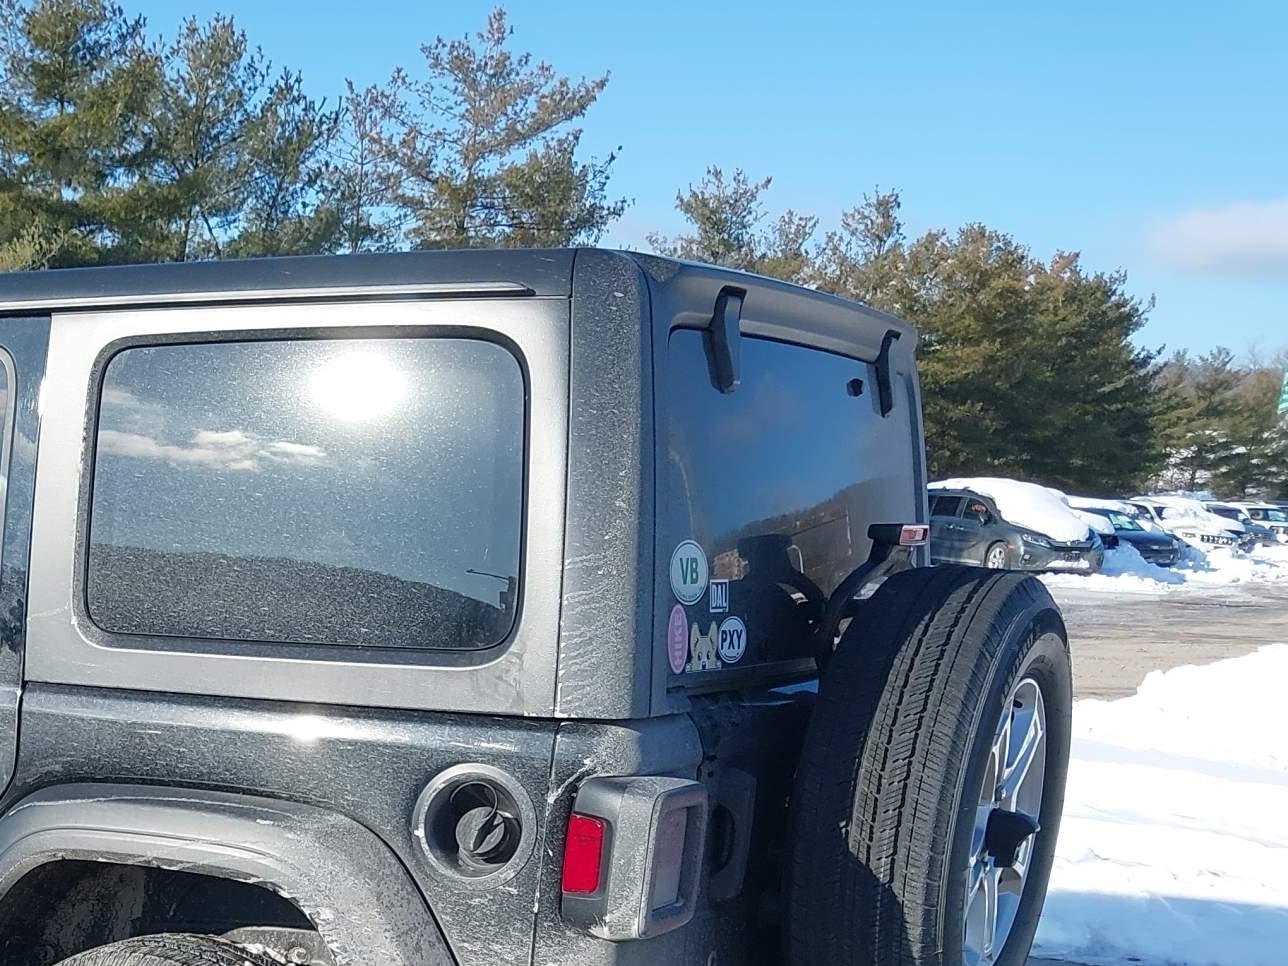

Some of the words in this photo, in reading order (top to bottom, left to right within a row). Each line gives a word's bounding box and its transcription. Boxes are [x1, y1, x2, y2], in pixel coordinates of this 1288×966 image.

[679, 557, 699, 585] VB
[711, 584, 727, 608] DAL
[721, 629, 743, 651] PXY
